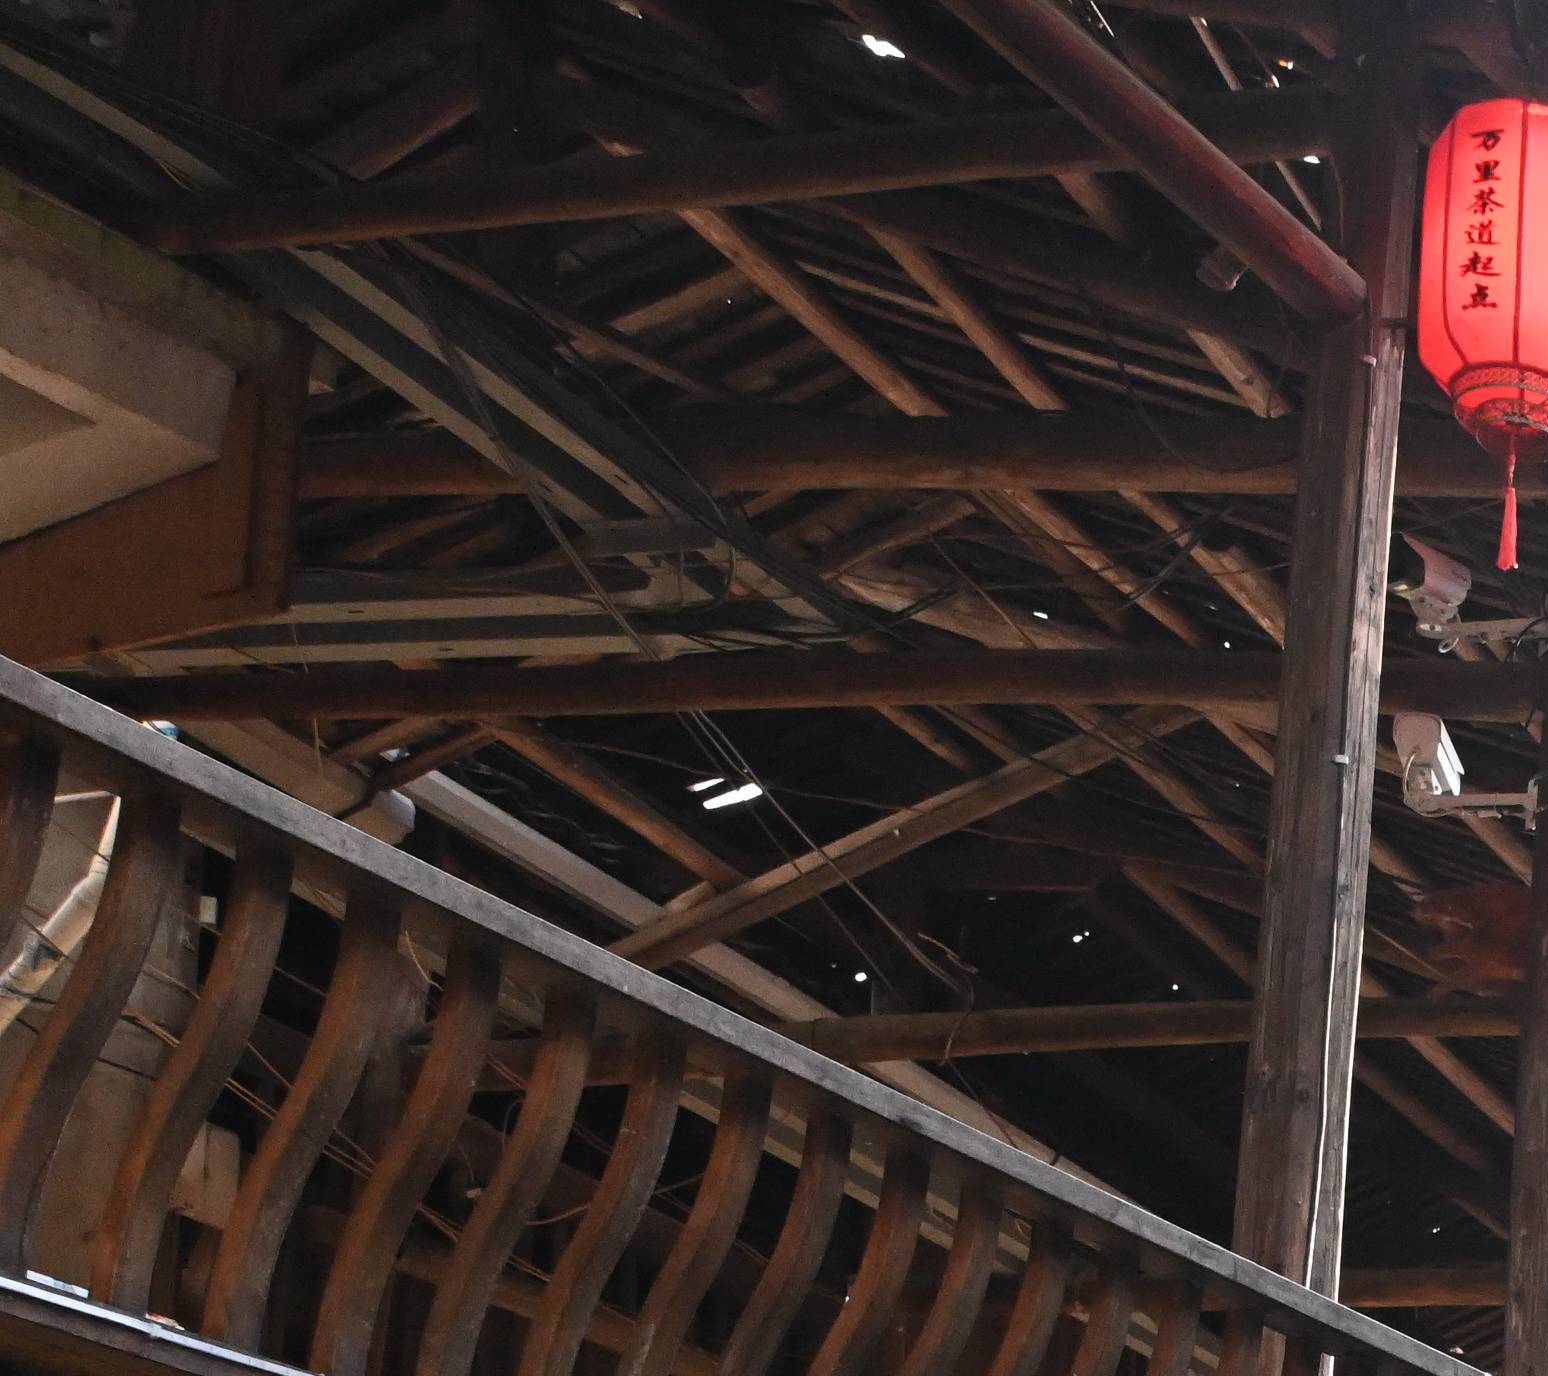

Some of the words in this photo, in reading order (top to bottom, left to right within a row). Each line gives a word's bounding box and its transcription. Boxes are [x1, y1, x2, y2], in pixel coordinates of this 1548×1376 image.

[1459, 128, 1505, 311] 万里茶道起点
